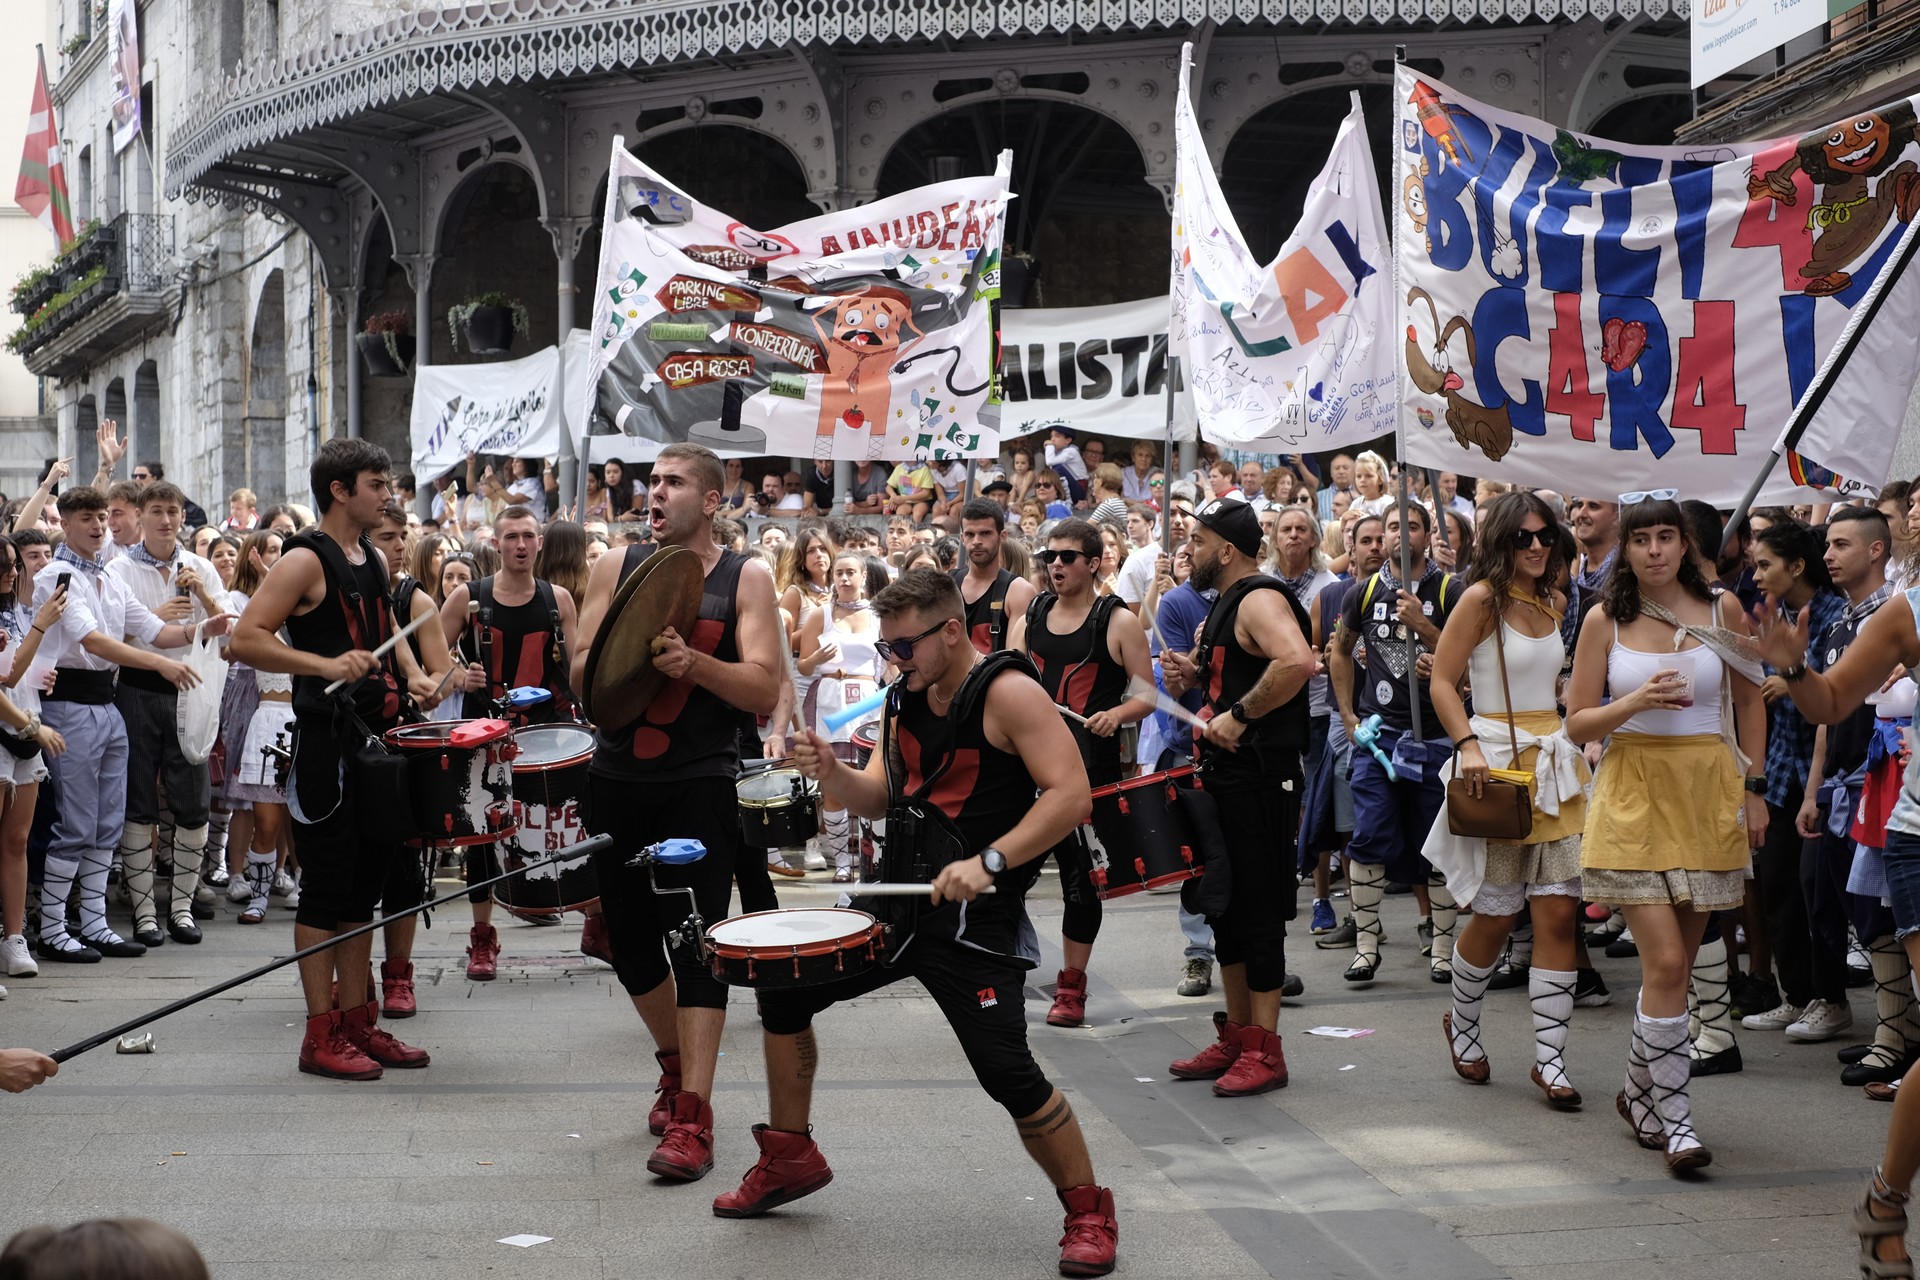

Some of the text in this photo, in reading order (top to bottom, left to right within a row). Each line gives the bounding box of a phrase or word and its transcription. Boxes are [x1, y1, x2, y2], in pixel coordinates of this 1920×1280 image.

[669, 280, 726, 302] PARKING
[673, 296, 709, 310] LIBRE
[735, 324, 819, 371] KONTZERTUAK
[664, 359, 750, 381] CASA ROSA
[1308, 386, 1337, 423] GONZALO
[1321, 397, 1343, 428] CALERA
